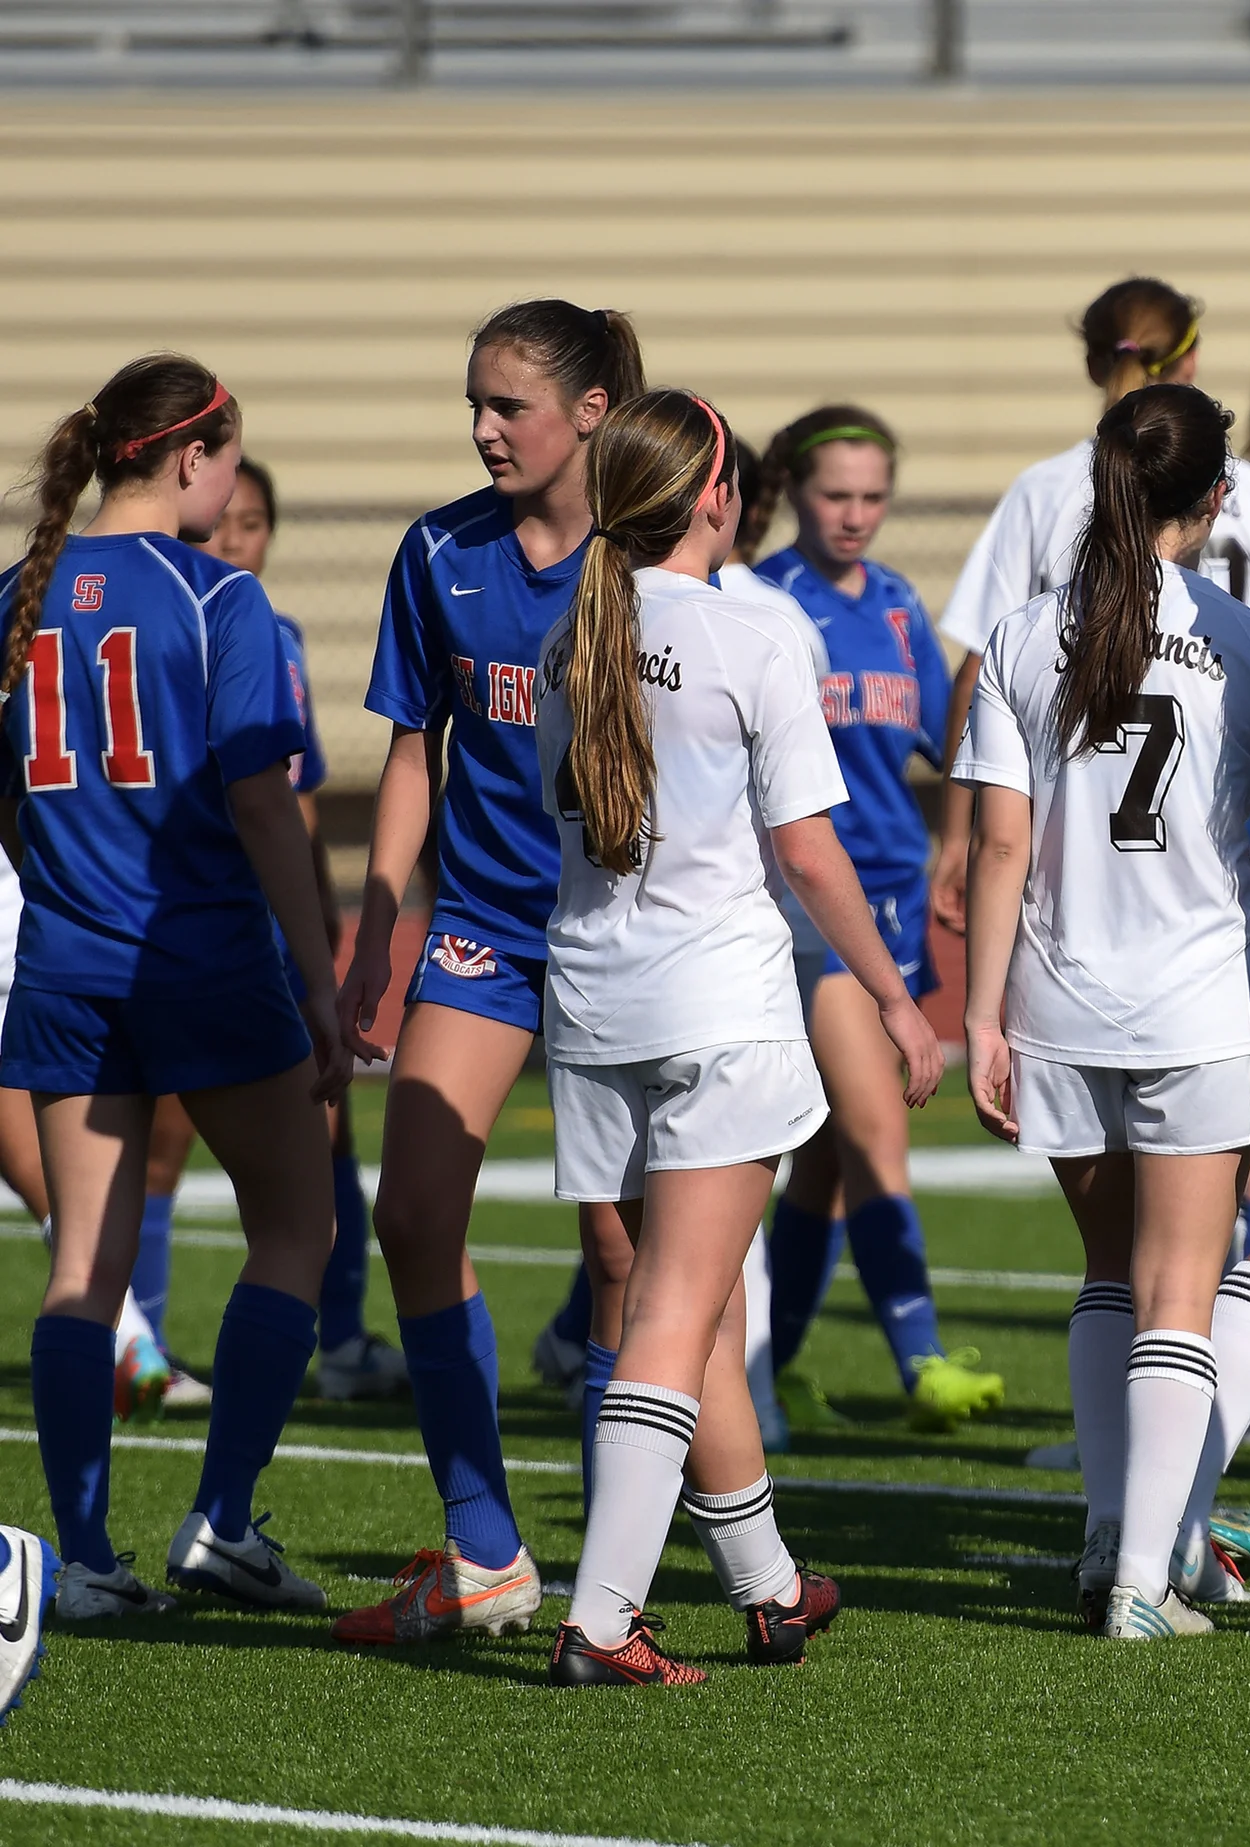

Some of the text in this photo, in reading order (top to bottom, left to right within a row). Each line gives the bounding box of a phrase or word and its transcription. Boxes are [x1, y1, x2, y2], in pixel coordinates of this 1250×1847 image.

[24, 627, 156, 792] 11
[1092, 693, 1185, 852] 7
[442, 956, 482, 975] WILDCATS
